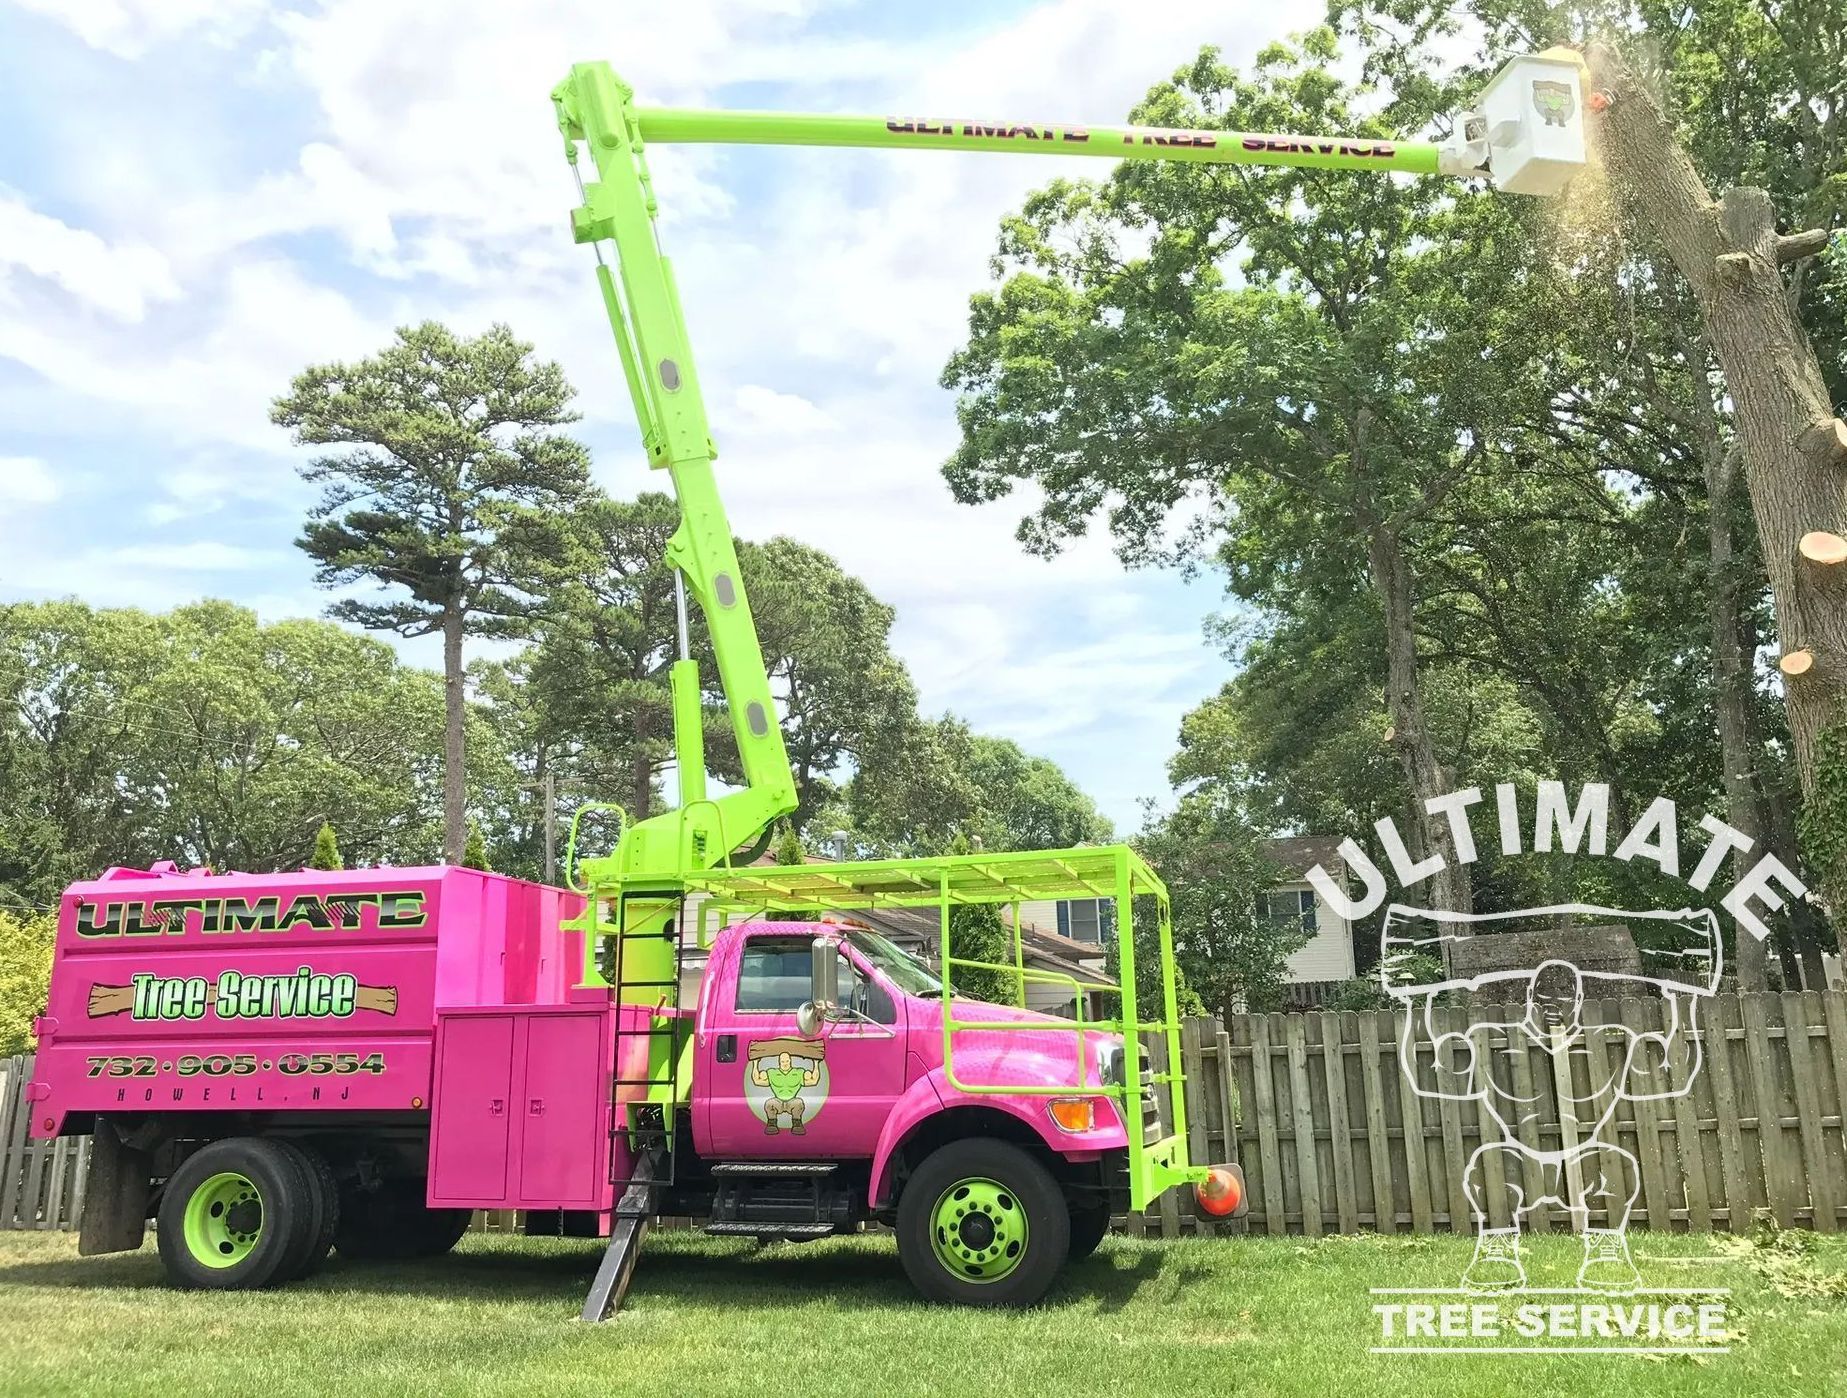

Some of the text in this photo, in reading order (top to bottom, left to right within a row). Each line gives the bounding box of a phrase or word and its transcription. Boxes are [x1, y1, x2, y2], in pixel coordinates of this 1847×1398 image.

[76, 892, 426, 937] ULTIMATE
[131, 964, 358, 1021] Tree Service
[313, 1086, 350, 1100] NJ
